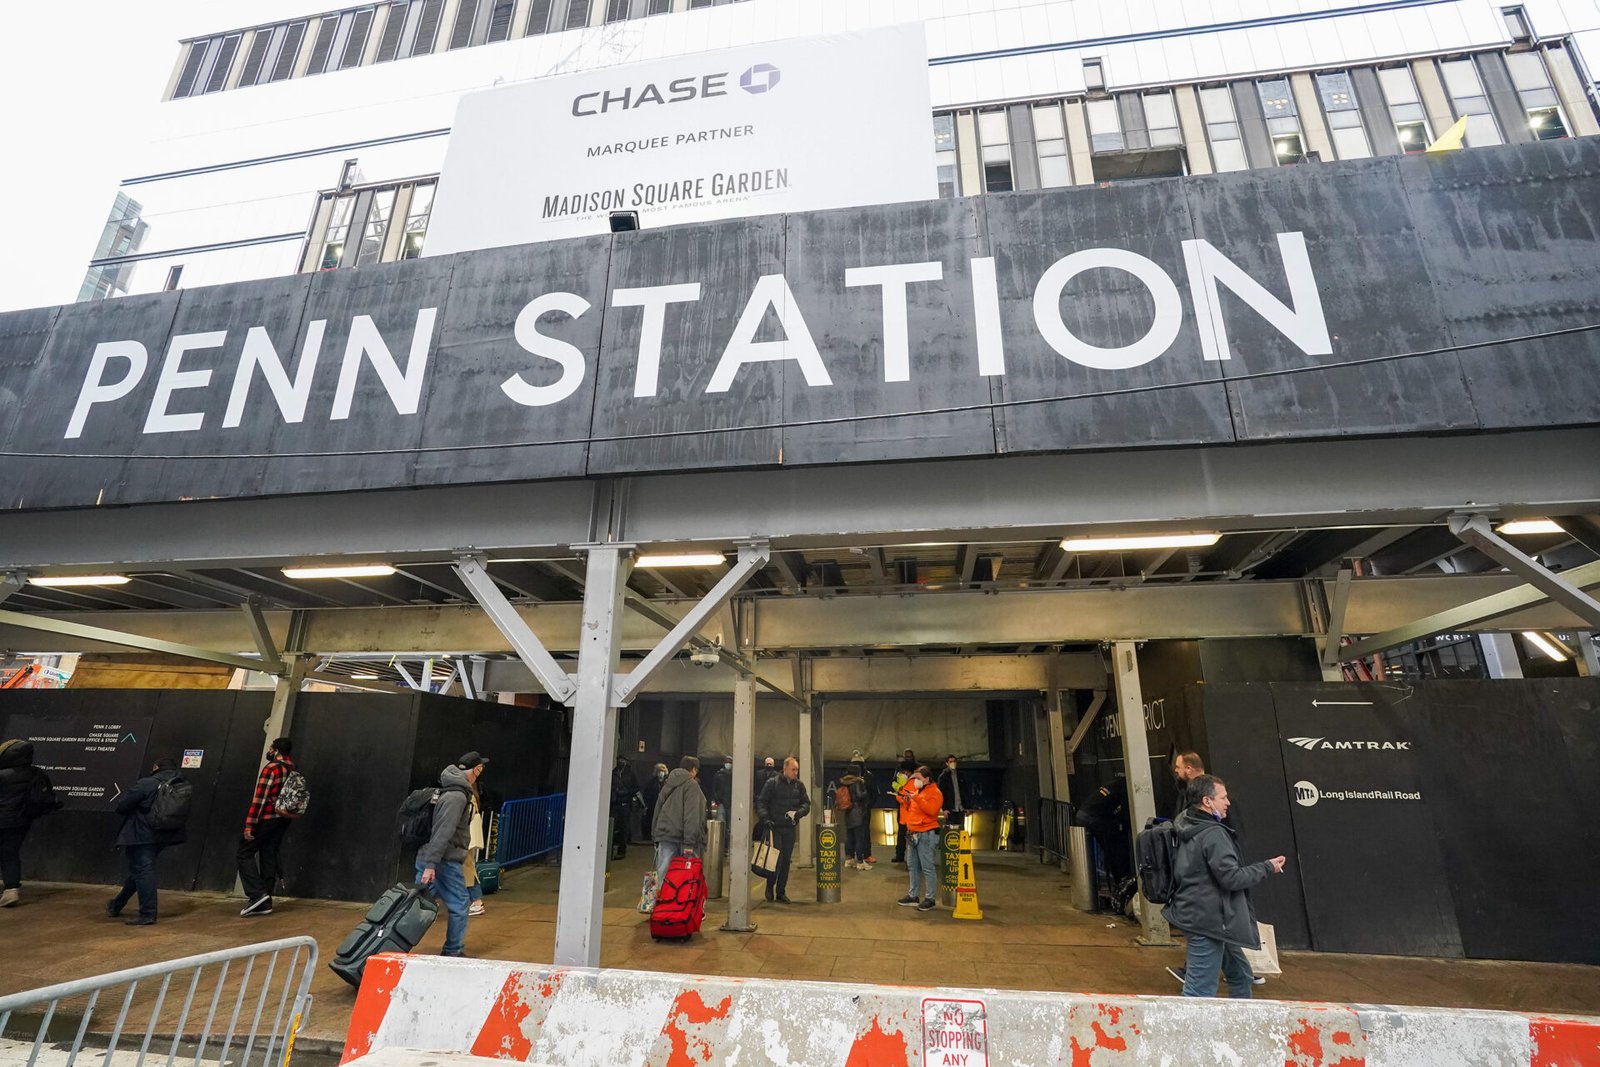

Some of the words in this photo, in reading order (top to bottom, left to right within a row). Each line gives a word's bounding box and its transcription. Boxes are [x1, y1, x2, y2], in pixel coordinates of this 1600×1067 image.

[571, 72, 729, 117] CHASE
[587, 136, 669, 158] MARQUEE
[676, 125, 754, 145] PARTNER
[542, 188, 626, 219] MADISON
[631, 177, 705, 207] SQUARE
[711, 168, 789, 196] GARDEN
[642, 205, 668, 213] MOST
[672, 201, 712, 210] FAMOUS
[64, 307, 437, 439] PENN
[500, 231, 1334, 407] STATION
[1321, 741, 1410, 750] AMTRAK
[1295, 786, 1316, 801] MTA
[1320, 790, 1344, 801] Long
[1345, 790, 1375, 799] Island
[1375, 790, 1394, 799] Rail
[1395, 791, 1421, 800] Road
[943, 1008, 964, 1026] NO
[928, 1029, 981, 1051] STOPPING
[942, 1053, 969, 1067] ANY
